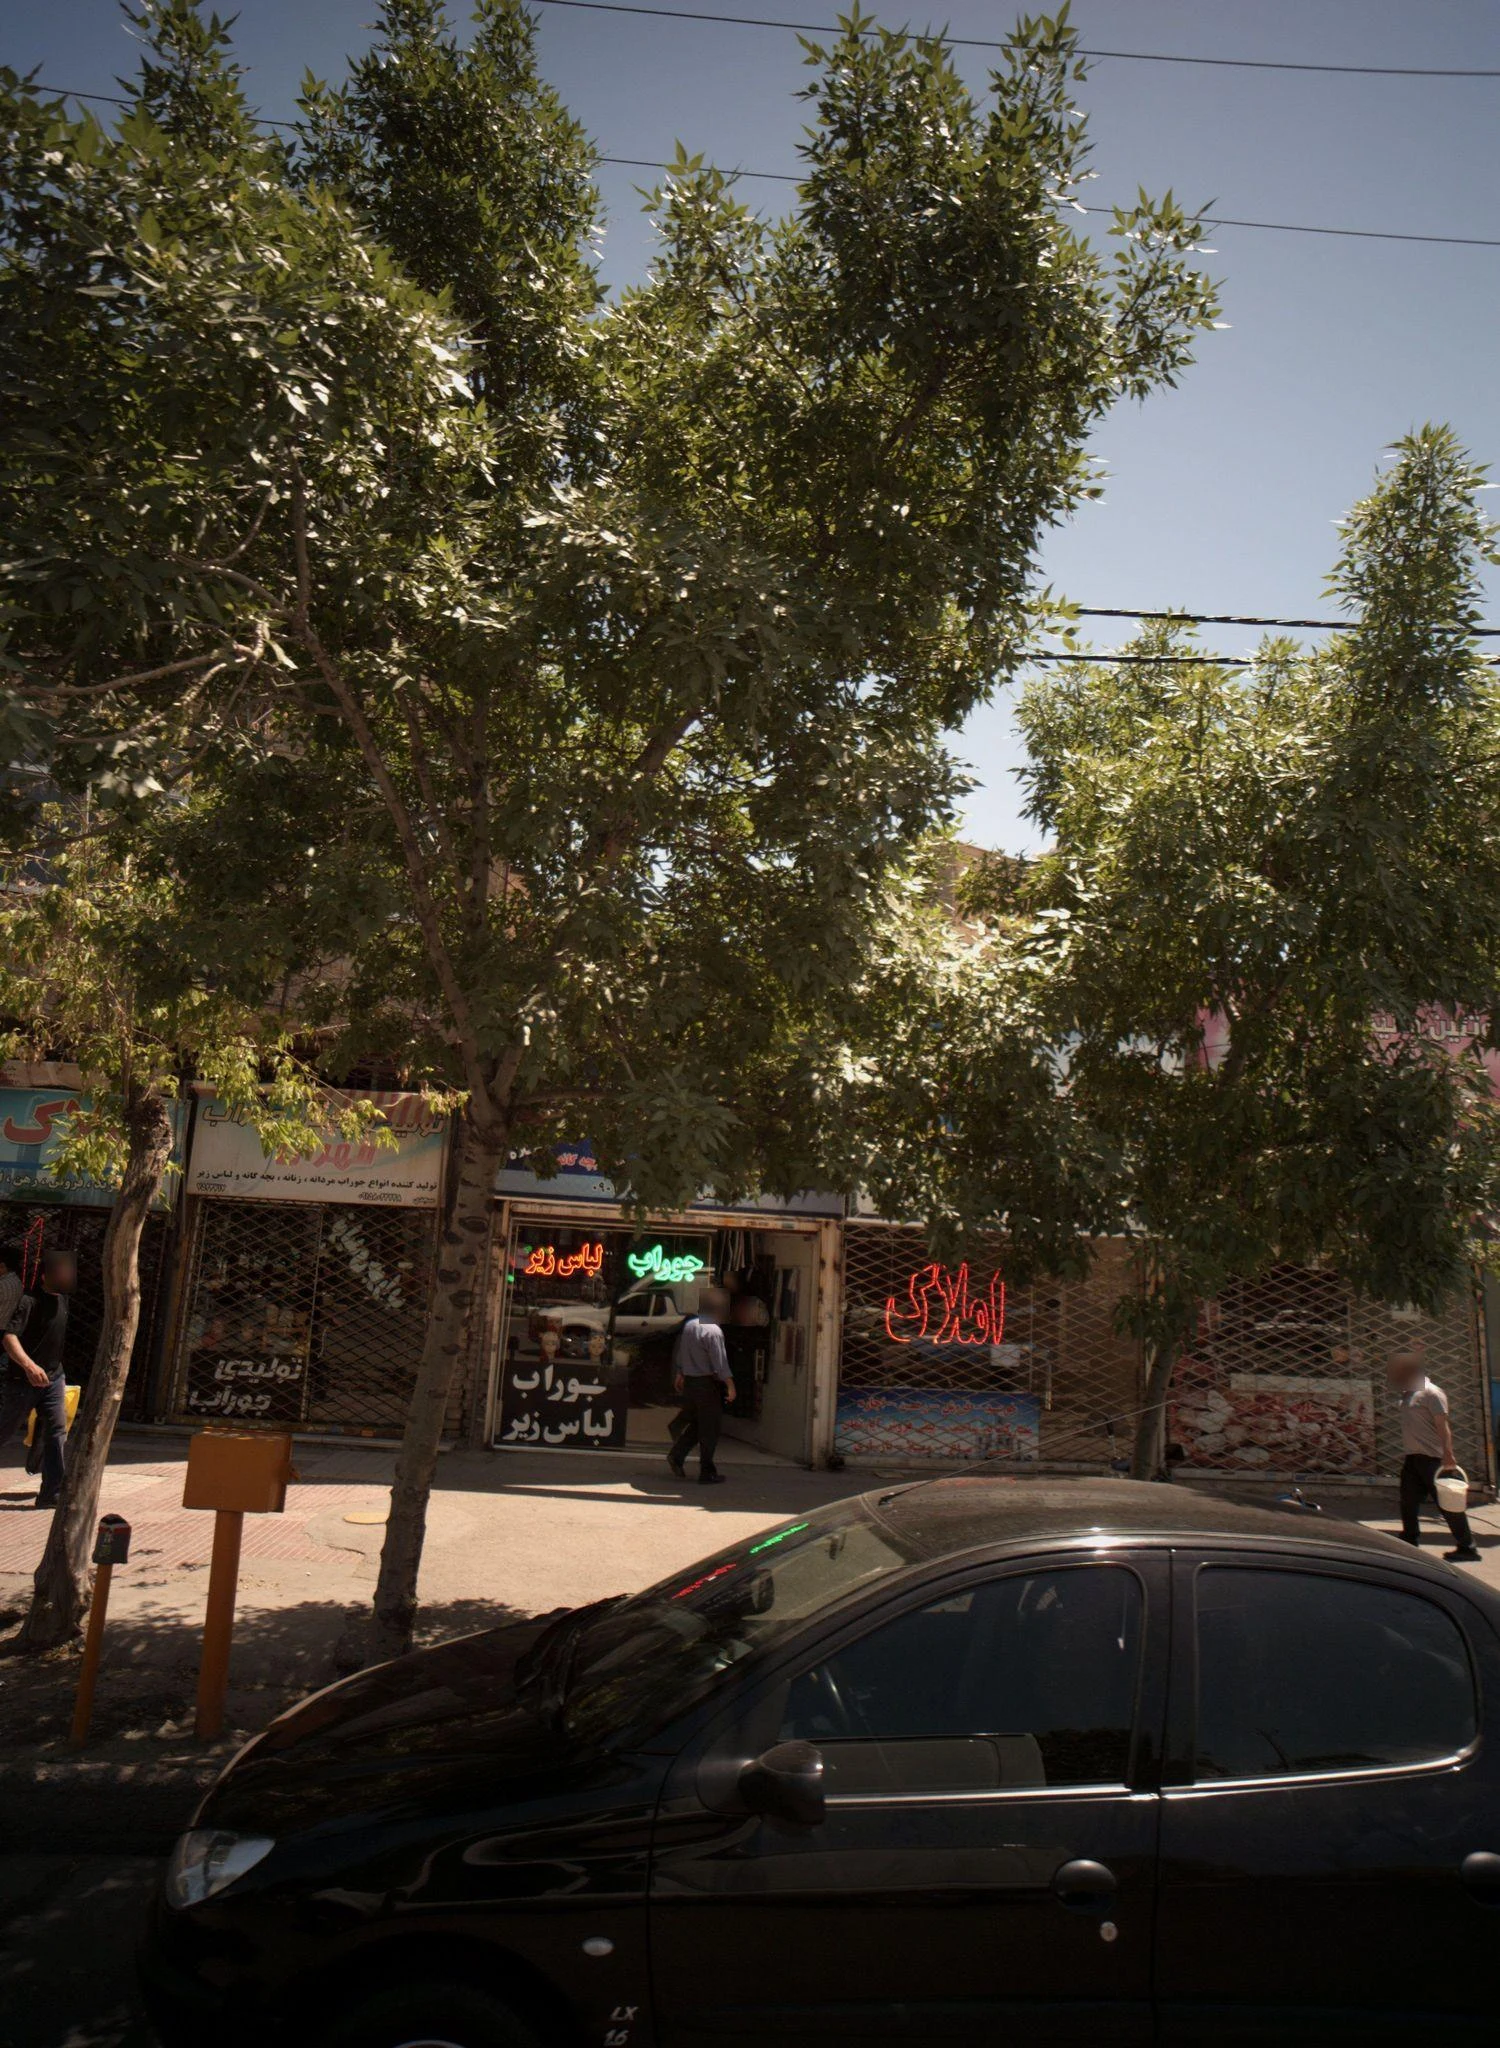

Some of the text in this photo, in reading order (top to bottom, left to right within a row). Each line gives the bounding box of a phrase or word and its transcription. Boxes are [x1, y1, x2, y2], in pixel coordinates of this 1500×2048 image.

[197, 1170, 210, 1179] زیر
[212, 1170, 233, 1179] لباس
[241, 1171, 258, 1180] گانه
[260, 1173, 275, 1182] بچه
[283, 1173, 302, 1184] زنانه
[310, 1176, 336, 1186] مردانه
[337, 1177, 366, 1188] جوراب
[368, 1179, 390, 1189] انواع
[391, 1180, 414, 1189] کننده
[416, 1181, 438, 1192] تولید
[525, 1243, 603, 1276] لباس زیر
[627, 1244, 704, 1282] جوراب
[885, 1261, 1006, 1345] املاک
[214, 1357, 303, 1384] تولیدی
[512, 1364, 607, 1402] جوراب
[189, 1385, 272, 1416] جوراب
[502, 1408, 615, 1446] لباس زیر
[608, 2006, 640, 2022] LX
